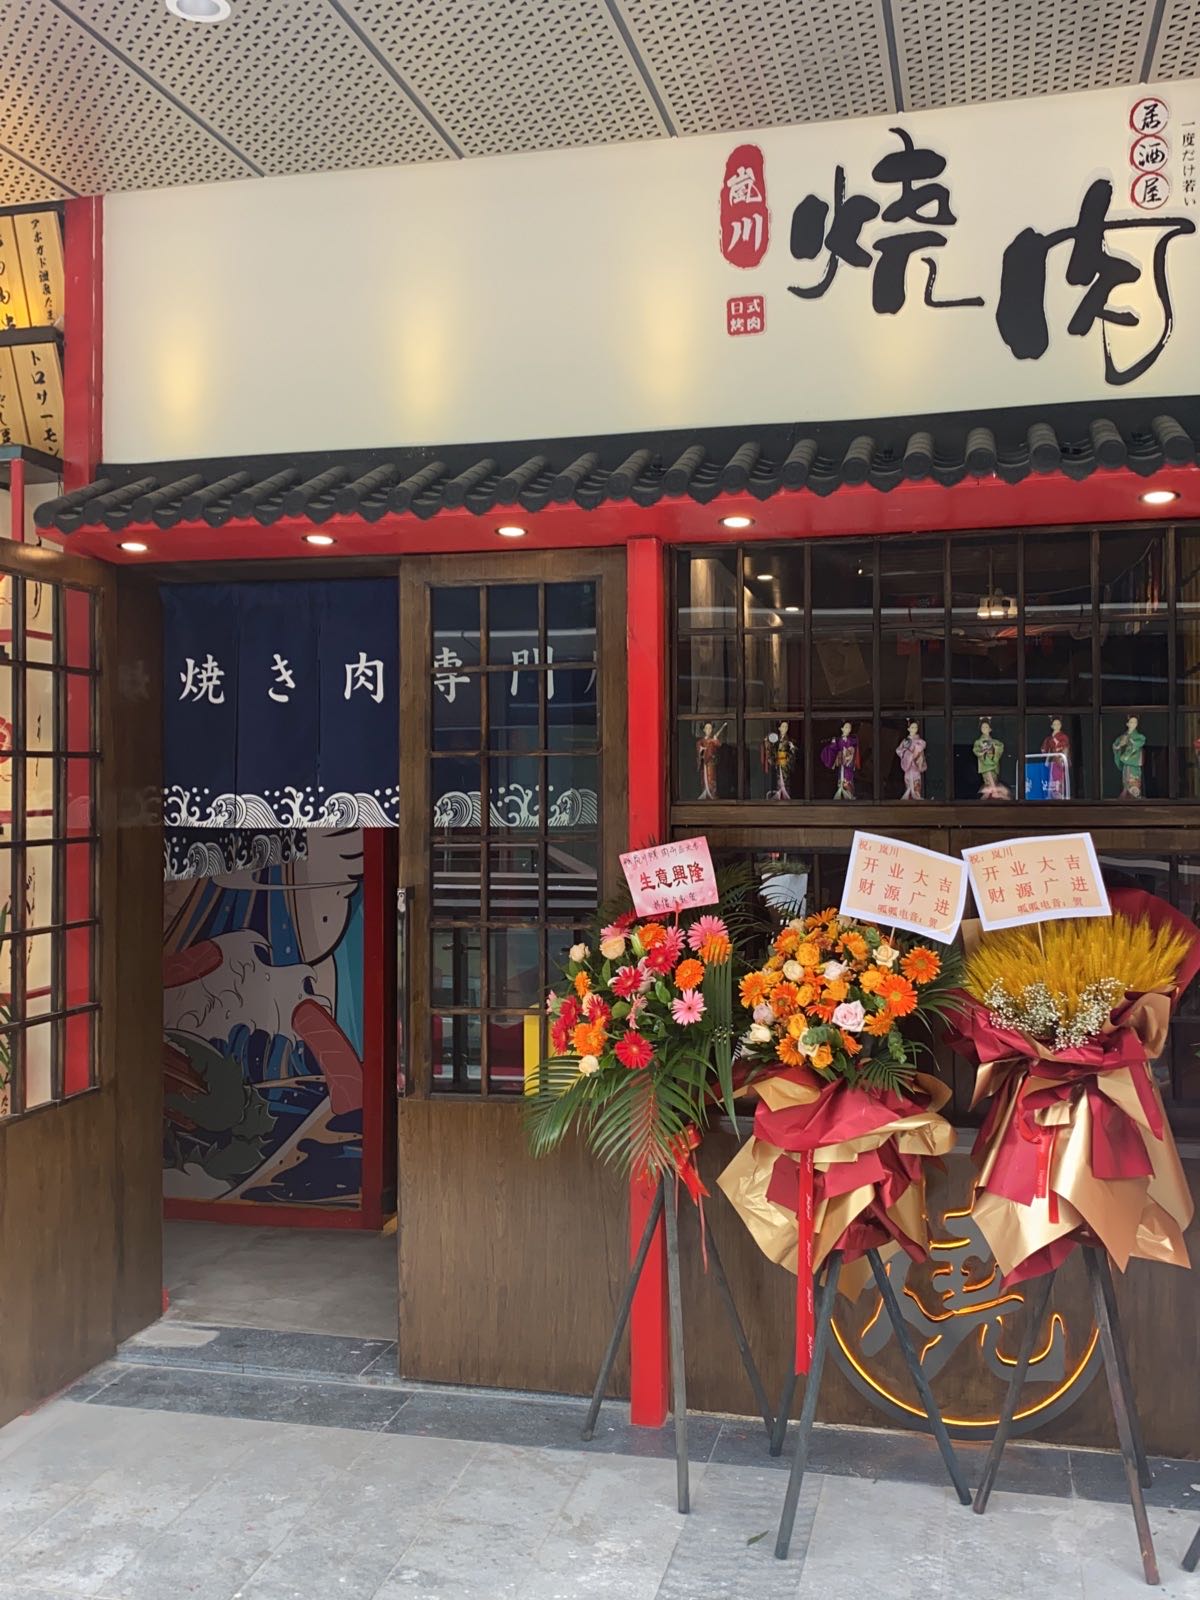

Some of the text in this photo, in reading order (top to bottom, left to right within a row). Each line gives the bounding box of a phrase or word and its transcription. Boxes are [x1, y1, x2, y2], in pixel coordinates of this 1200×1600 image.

[1139, 103, 1165, 204] 居酒屋
[863, 856, 952, 894] 开业大吉
[983, 854, 1080, 882] 开业大吉
[858, 878, 950, 916] 财源广进
[987, 876, 1089, 904] 财源广进
